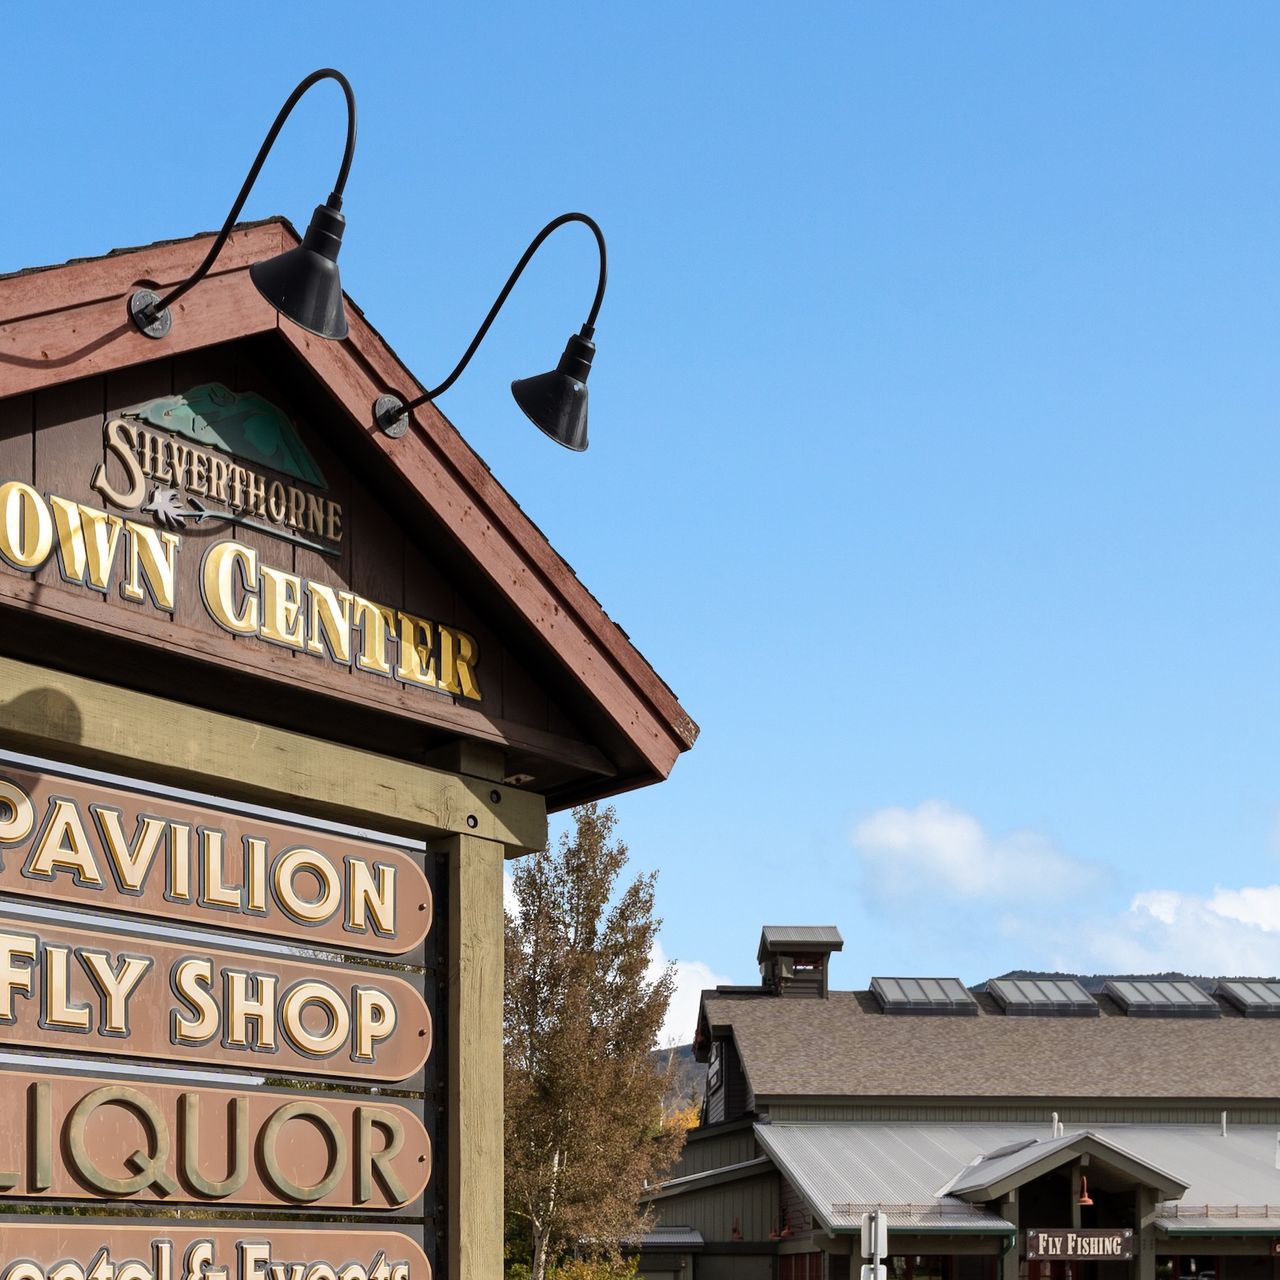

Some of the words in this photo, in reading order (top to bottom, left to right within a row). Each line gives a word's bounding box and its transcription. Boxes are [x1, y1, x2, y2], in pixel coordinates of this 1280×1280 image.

[92, 418, 342, 543] SILVERTHORNE
[200, 540, 482, 701] CENTER
[173, 957, 397, 1063] SHOP
[1038, 1233, 1063, 1255] FLY
[1066, 1233, 1122, 1255] FISHING
